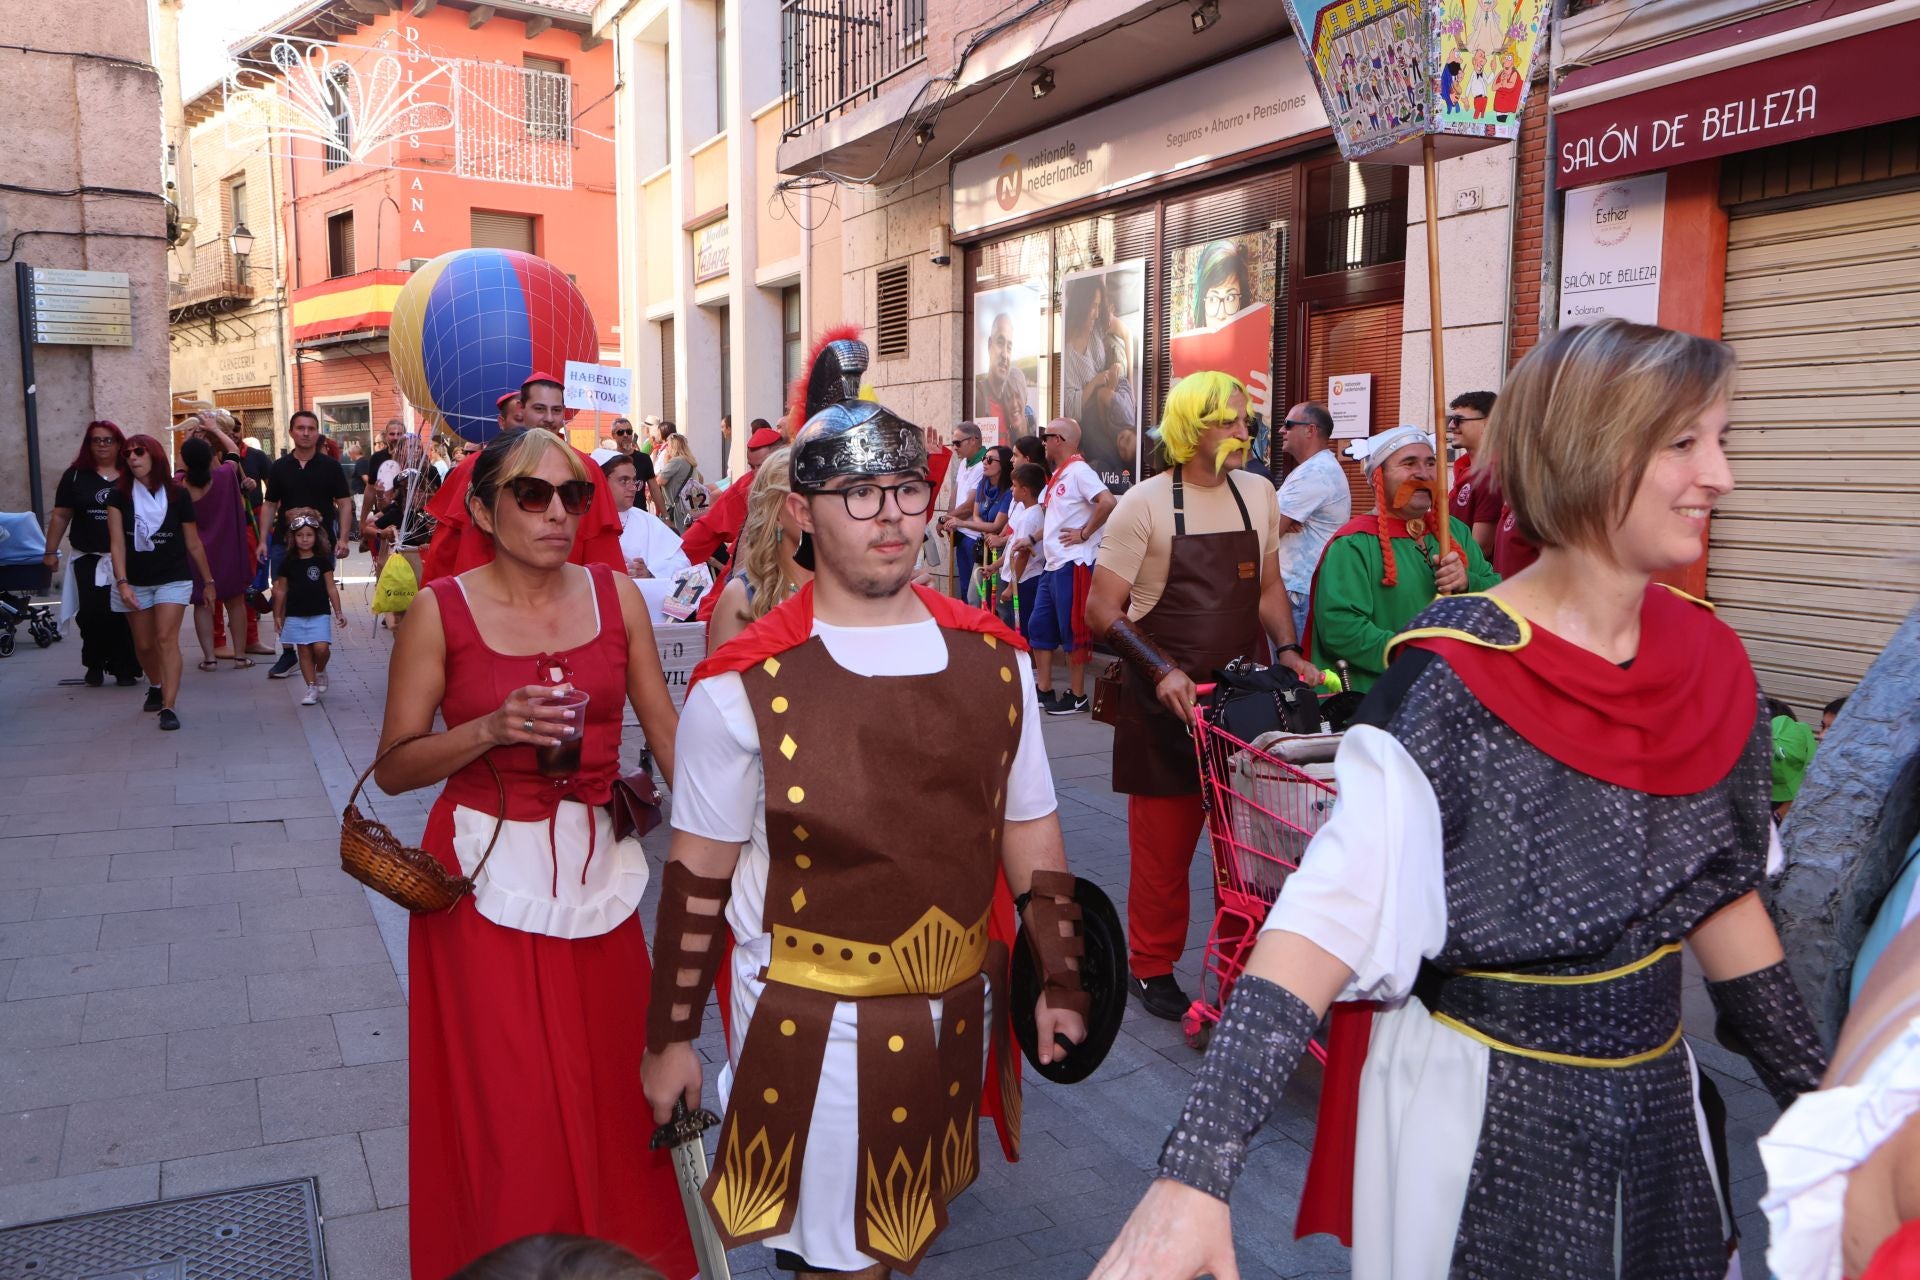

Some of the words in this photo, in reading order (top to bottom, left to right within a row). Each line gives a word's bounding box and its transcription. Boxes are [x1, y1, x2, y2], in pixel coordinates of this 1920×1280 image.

[1166, 126, 1203, 148] Seguros
[1211, 113, 1244, 135] Ahorro
[1253, 93, 1307, 121] Pensiones
[1562, 122, 1638, 174] SALÓN
[1652, 113, 1689, 153] DE
[1702, 84, 1817, 142] BELLEZA
[1027, 139, 1076, 171] nationale
[1027, 158, 1093, 193] nederlanden
[410, 176, 426, 233] ANA
[1595, 206, 1629, 224] Esther
[1564, 271, 1595, 289] SALÓN
[1599, 270, 1613, 285] DE
[1617, 265, 1657, 283] BELLEZA
[1574, 304, 1605, 316] Solarium
[570, 370, 627, 388] HABEMUS
[1101, 471, 1120, 485] Vida
[685, 493, 709, 509] 12
[672, 578, 705, 605] 11
[663, 670, 688, 686] VIL
